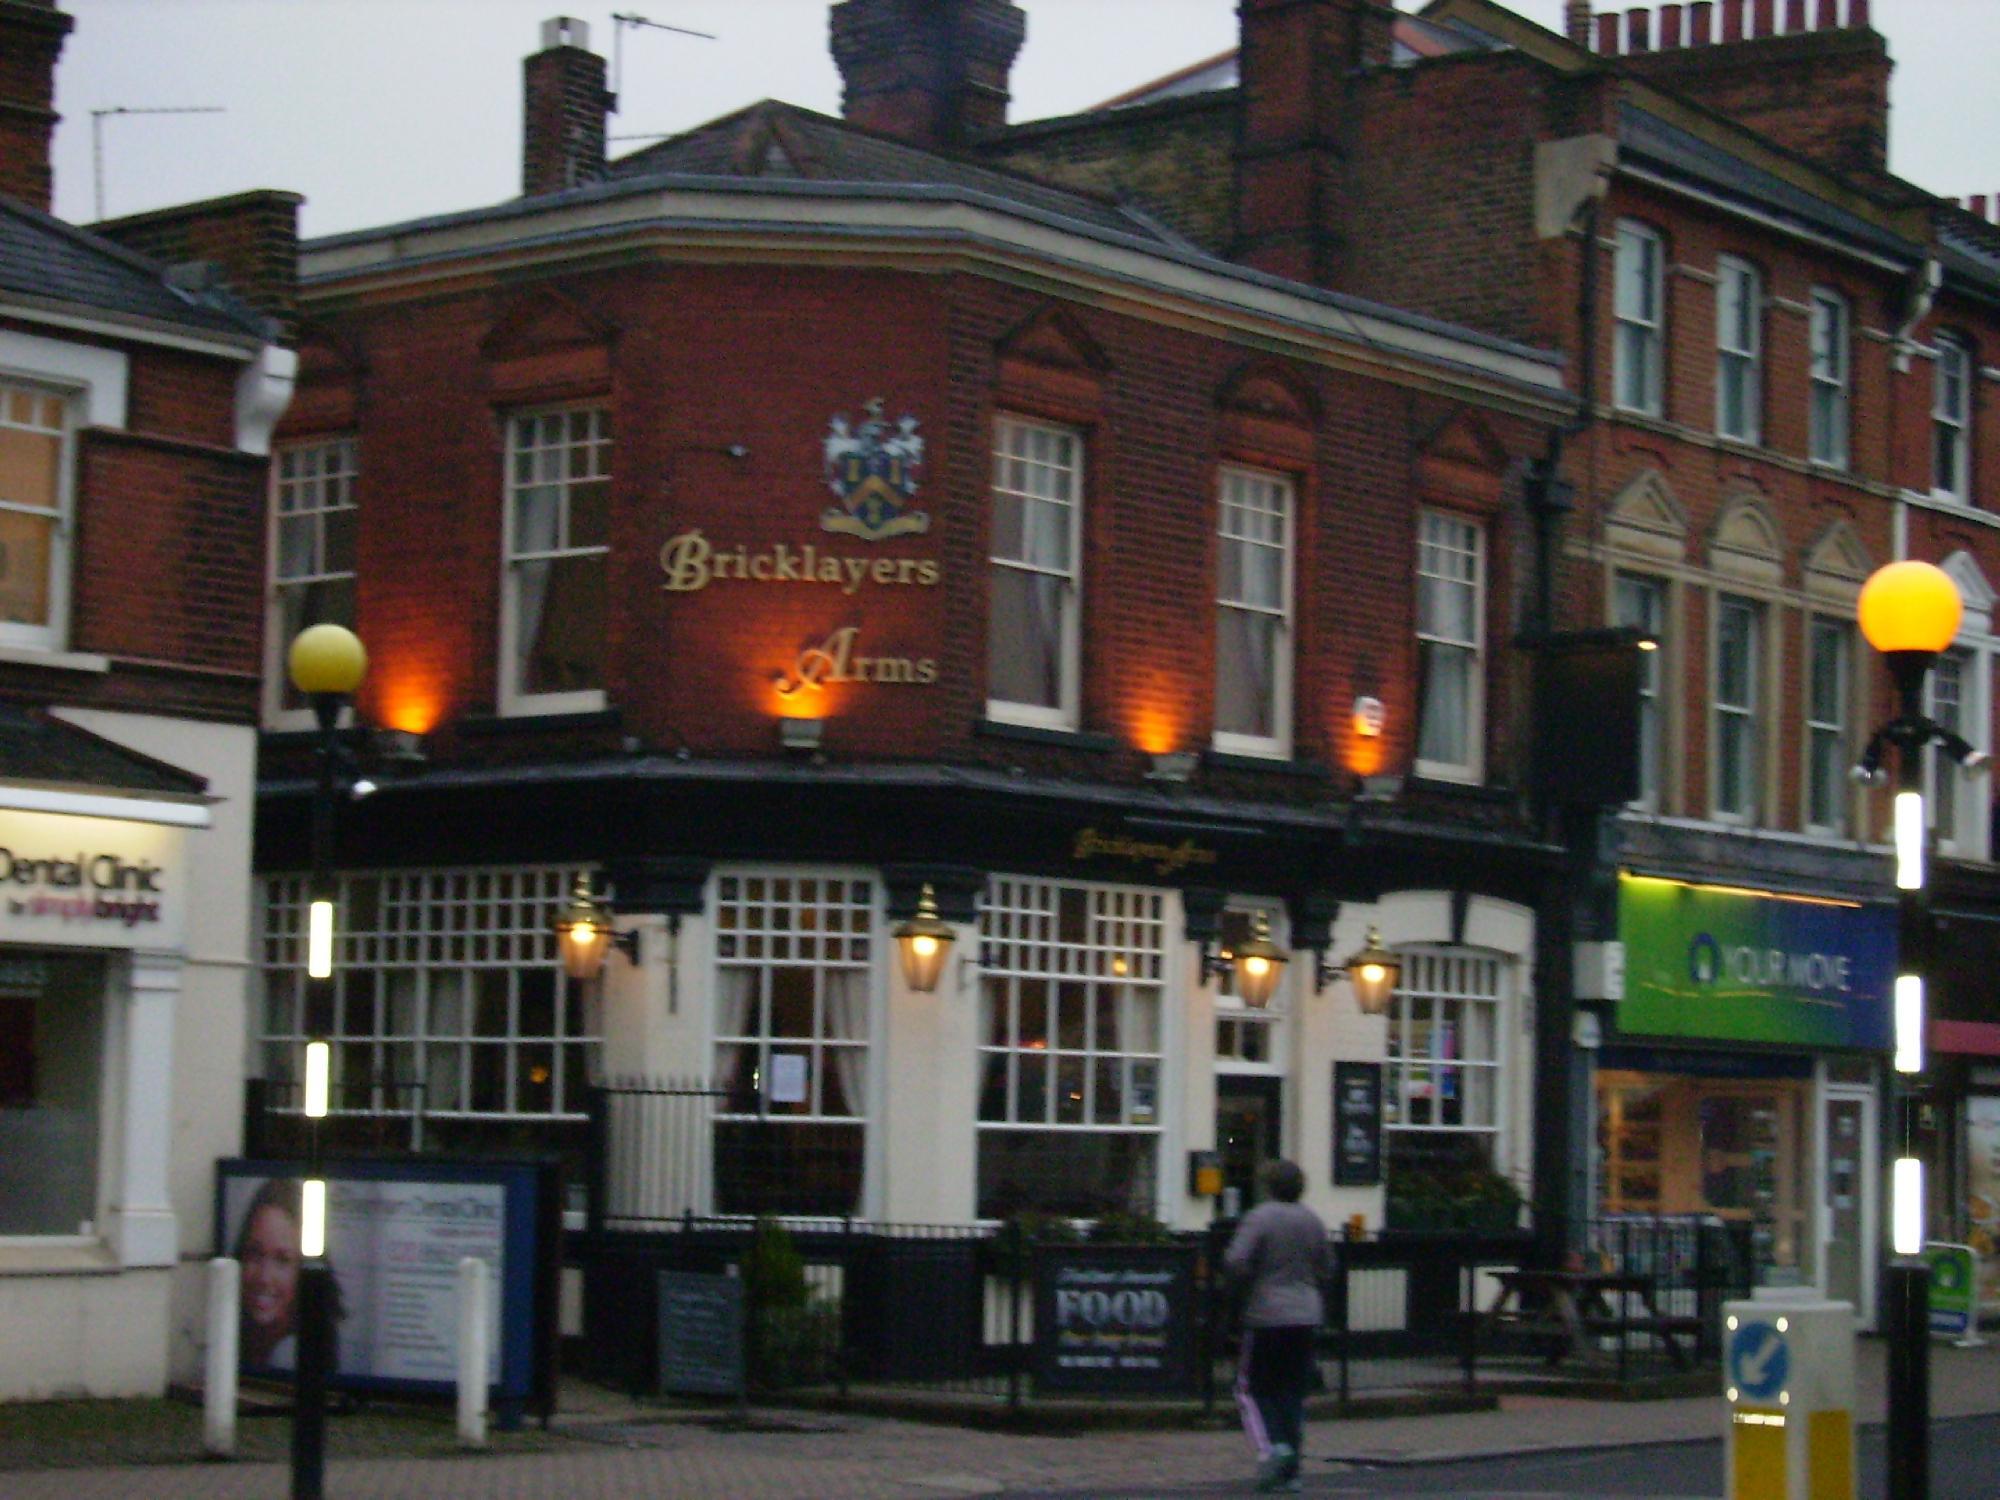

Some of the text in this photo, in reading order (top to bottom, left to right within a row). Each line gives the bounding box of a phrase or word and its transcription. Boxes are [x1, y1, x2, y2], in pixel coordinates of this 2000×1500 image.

[659, 529, 941, 594] Bricklayers
[771, 626, 939, 698] Arms
[92, 853, 162, 892] Clinic
[1056, 1289, 1169, 1328] FOOD
